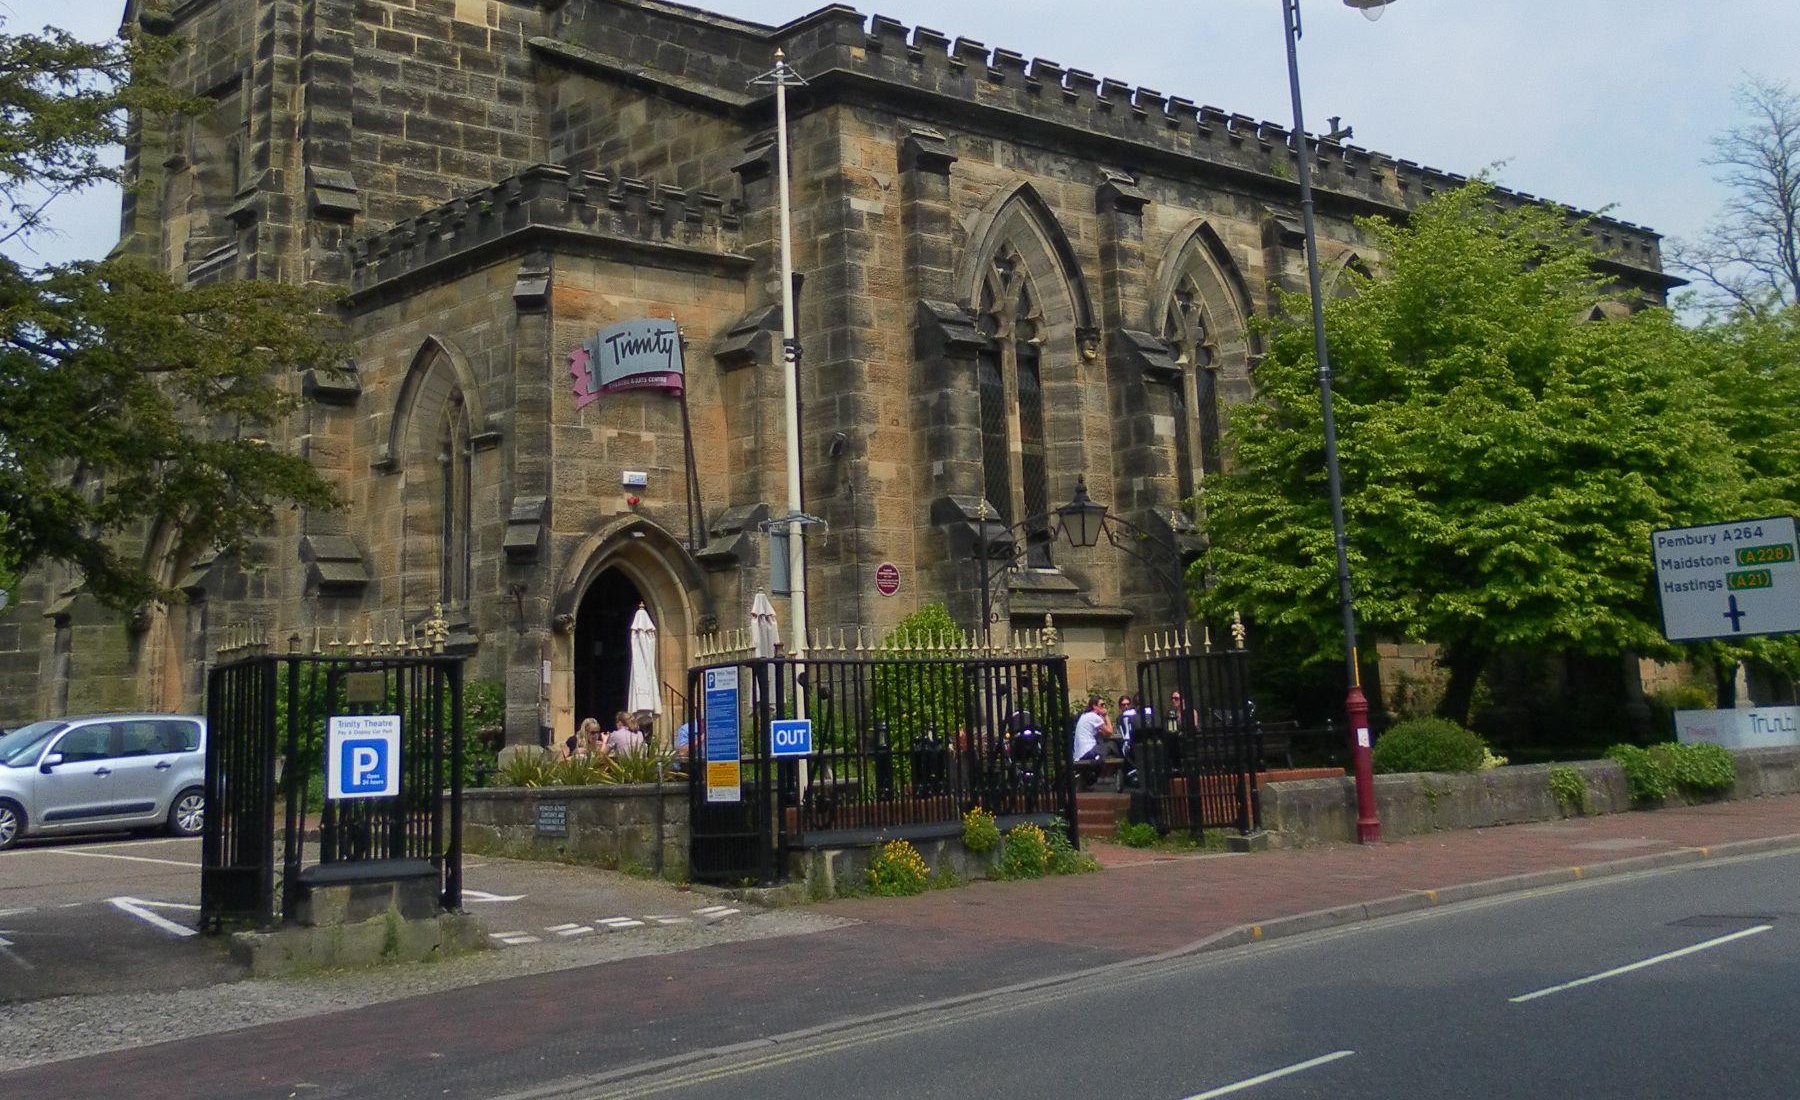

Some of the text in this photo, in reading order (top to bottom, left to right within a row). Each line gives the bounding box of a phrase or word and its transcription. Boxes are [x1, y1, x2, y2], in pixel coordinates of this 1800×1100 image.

[605, 328, 675, 368] Trinity
[1658, 526, 1763, 548] Pembury A264
[1661, 555, 1730, 570] Maidstone
[1664, 579, 1723, 593] Hastings
[338, 719, 393, 728] Trinity Theatre
[776, 729, 806, 746] OUT
[352, 747, 379, 786] P
